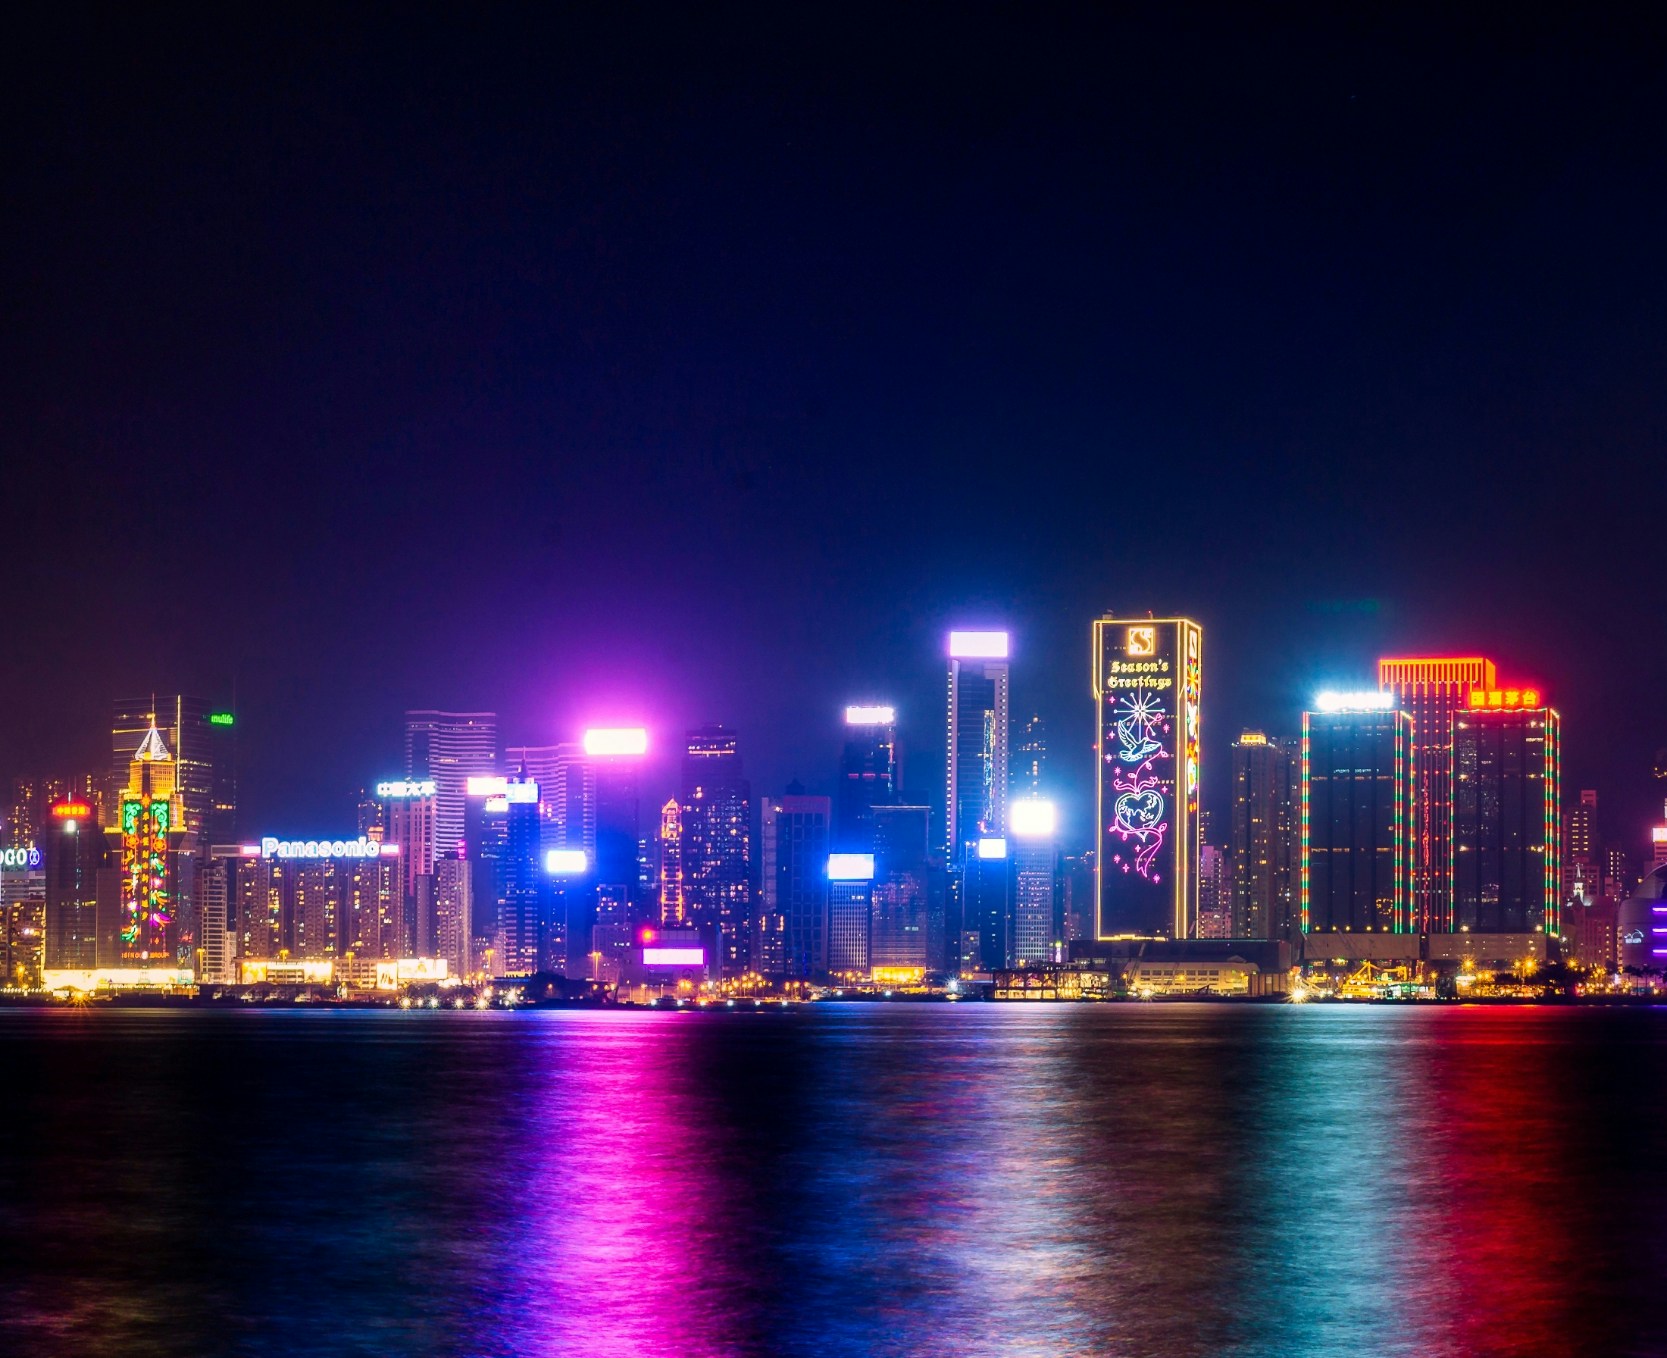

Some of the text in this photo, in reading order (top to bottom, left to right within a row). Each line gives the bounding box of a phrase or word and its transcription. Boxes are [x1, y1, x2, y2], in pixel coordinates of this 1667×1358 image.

[1111, 659, 1168, 673] Season's
[1107, 675, 1172, 690] Greetings
[261, 836, 380, 858] Panasonic
